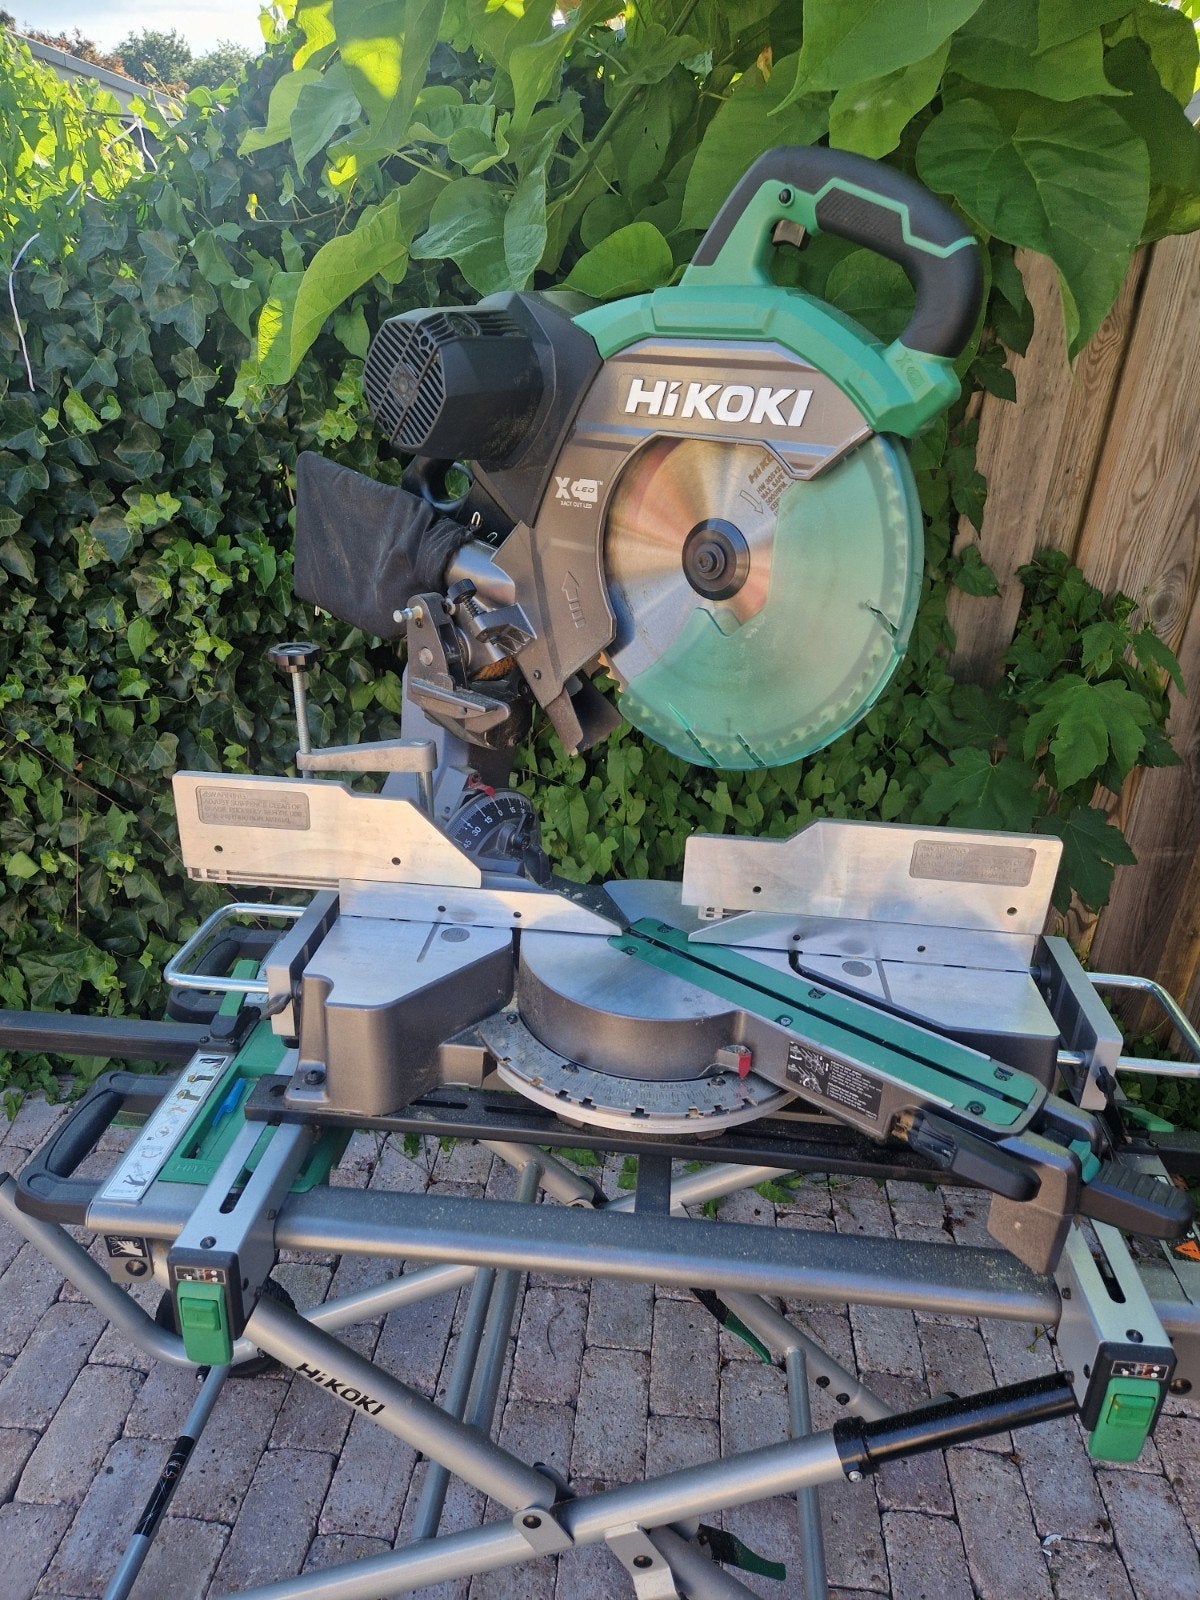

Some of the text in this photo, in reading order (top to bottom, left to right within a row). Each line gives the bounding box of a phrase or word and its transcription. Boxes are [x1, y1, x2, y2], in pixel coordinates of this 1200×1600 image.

[625, 379, 814, 427] HiKOKI
[575, 486, 595, 494] LED
[472, 826, 482, 837] 30
[484, 815, 493, 824] 15
[295, 1362, 386, 1416] HiKOKI
